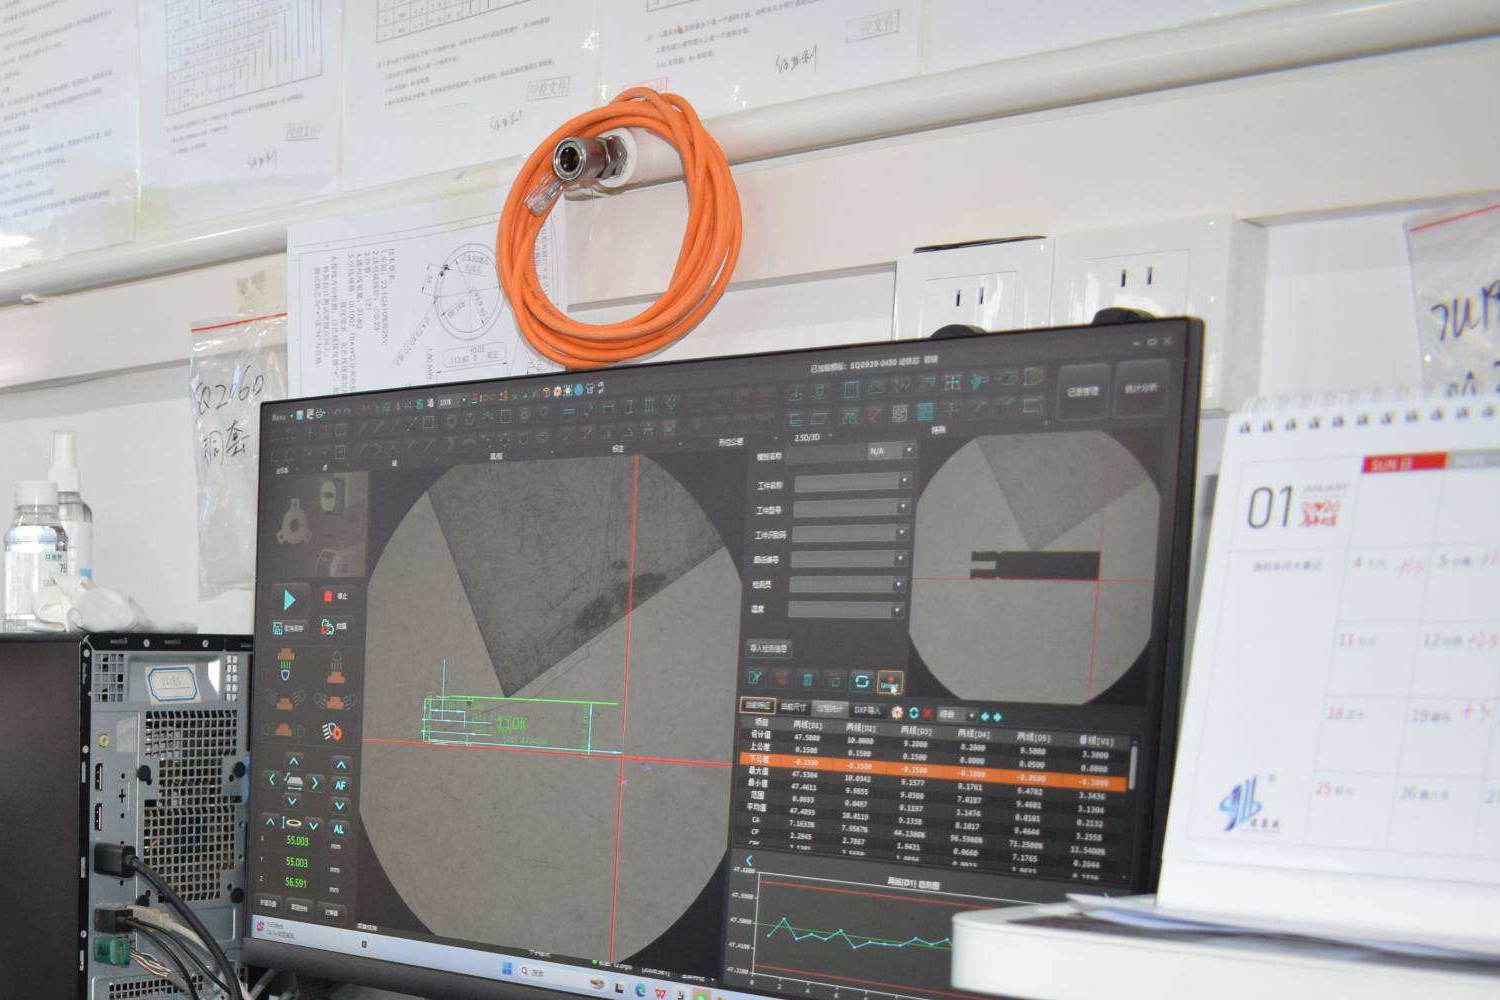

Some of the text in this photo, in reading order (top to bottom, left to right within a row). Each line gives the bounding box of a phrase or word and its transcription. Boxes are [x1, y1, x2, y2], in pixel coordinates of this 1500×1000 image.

[869, 446, 884, 457] N/A
[1370, 459, 1396, 471] SUN
[1247, 485, 1294, 529] 01
[1354, 557, 1364, 568] 4
[1439, 556, 1447, 567] 5
[1338, 633, 1355, 647] 11
[1424, 633, 1440, 647] 12
[1327, 707, 1344, 720] 18
[1411, 709, 1429, 723] 19
[755, 718, 769, 726] 项目
[752, 730, 771, 740] 设计值
[751, 742, 770, 752] 上公差
[749, 755, 769, 764] 下公差
[749, 767, 769, 776] 最大值
[335, 780, 347, 791] AF
[748, 779, 768, 788] 最小值
[1315, 781, 1332, 795] 25
[752, 791, 764, 800] 范围
[1400, 786, 1416, 800] 26
[747, 803, 766, 812] 平均值
[333, 825, 344, 834] AL
[286, 835, 309, 847] 55.003
[286, 856, 308, 868] 55.003
[285, 877, 307, 889] 56.591
